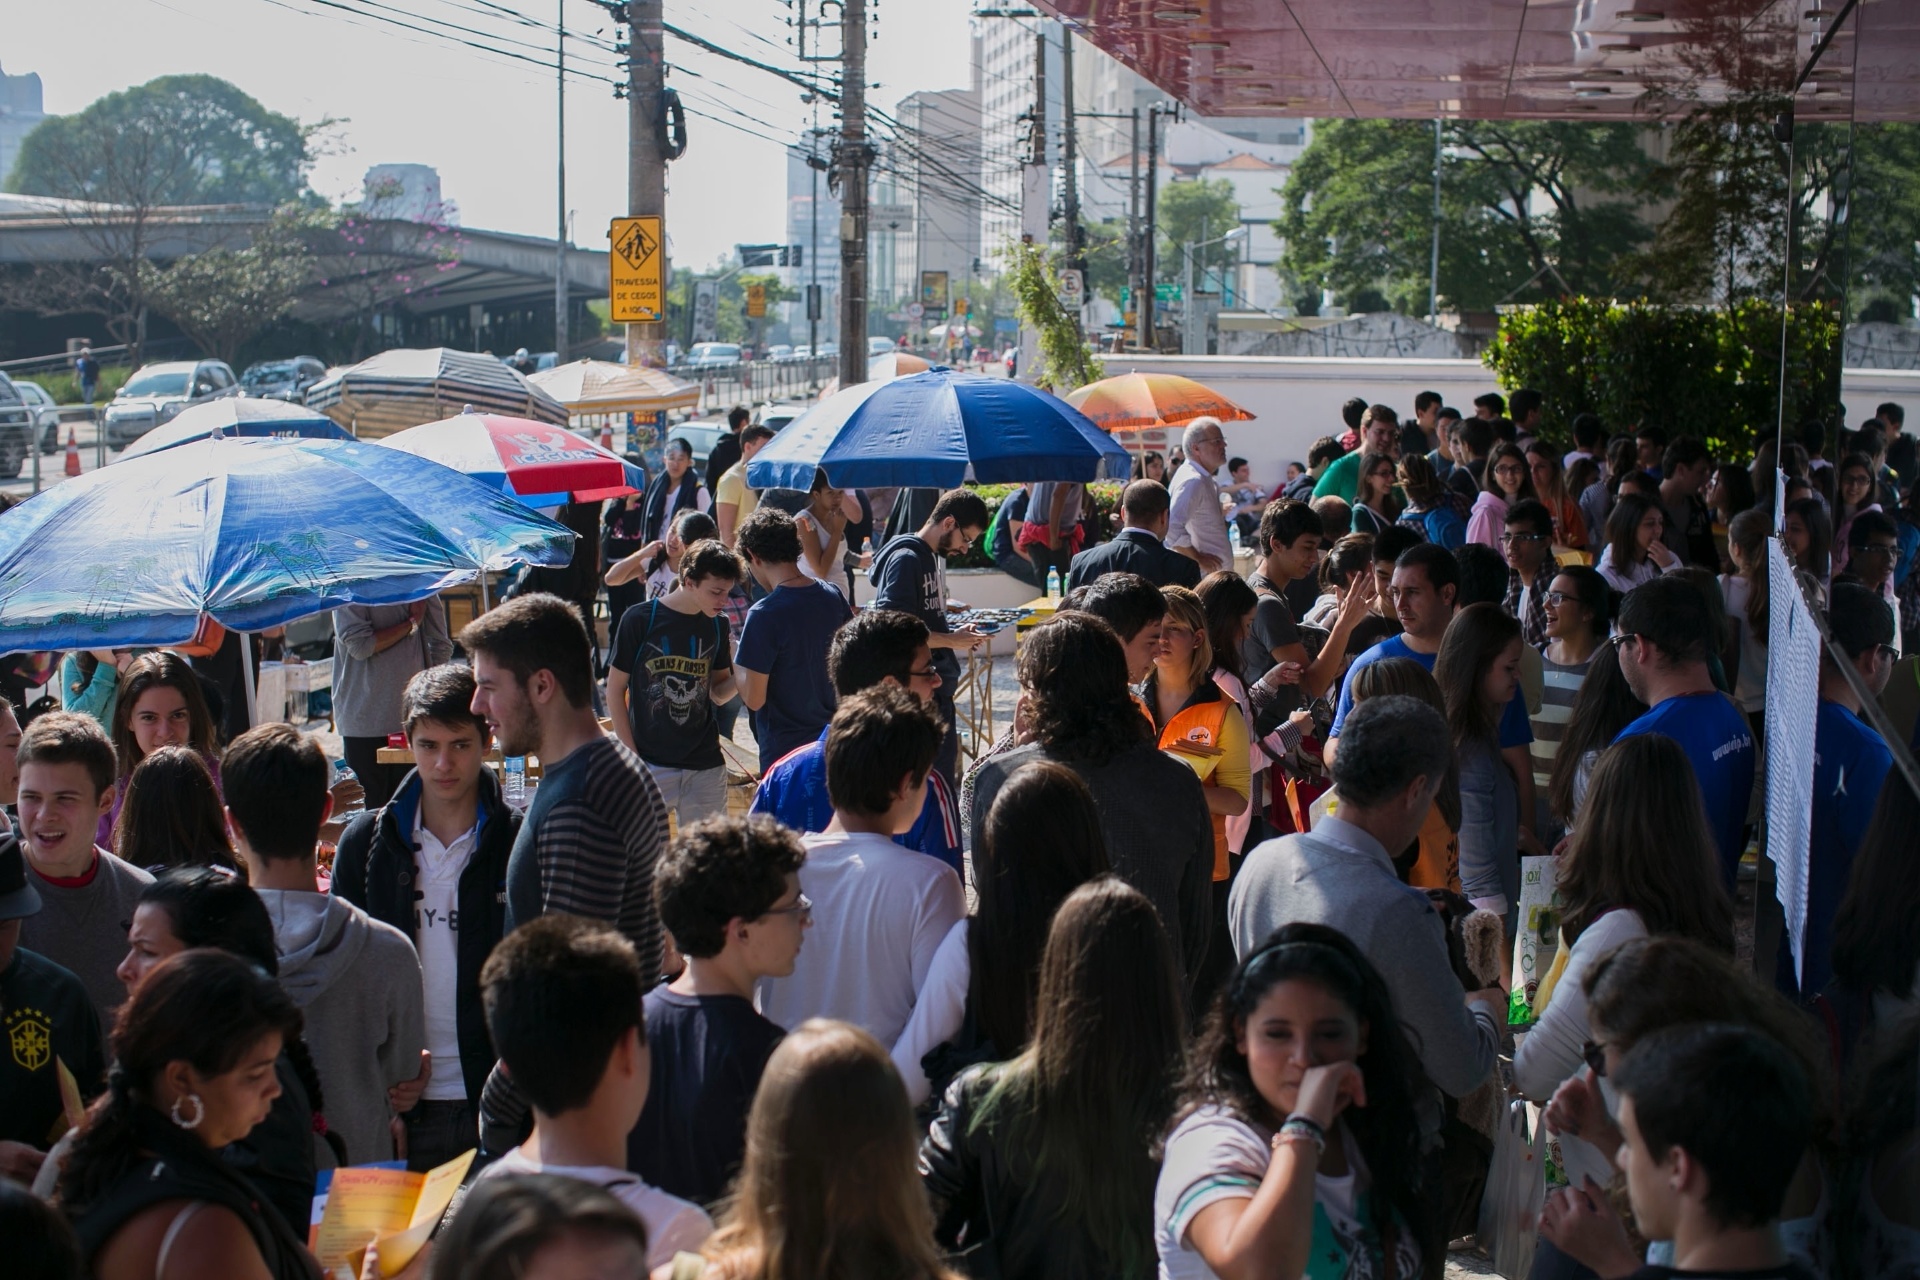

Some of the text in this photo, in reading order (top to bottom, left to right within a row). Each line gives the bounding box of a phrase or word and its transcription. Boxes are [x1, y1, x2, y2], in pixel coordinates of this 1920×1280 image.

[615, 278, 658, 286] TRAVESSIA
[617, 291, 657, 300] DE CEGOS
[654, 658, 676, 670] GUNS
[684, 661, 706, 674] ROSES
[1191, 733, 1209, 741] CPV
